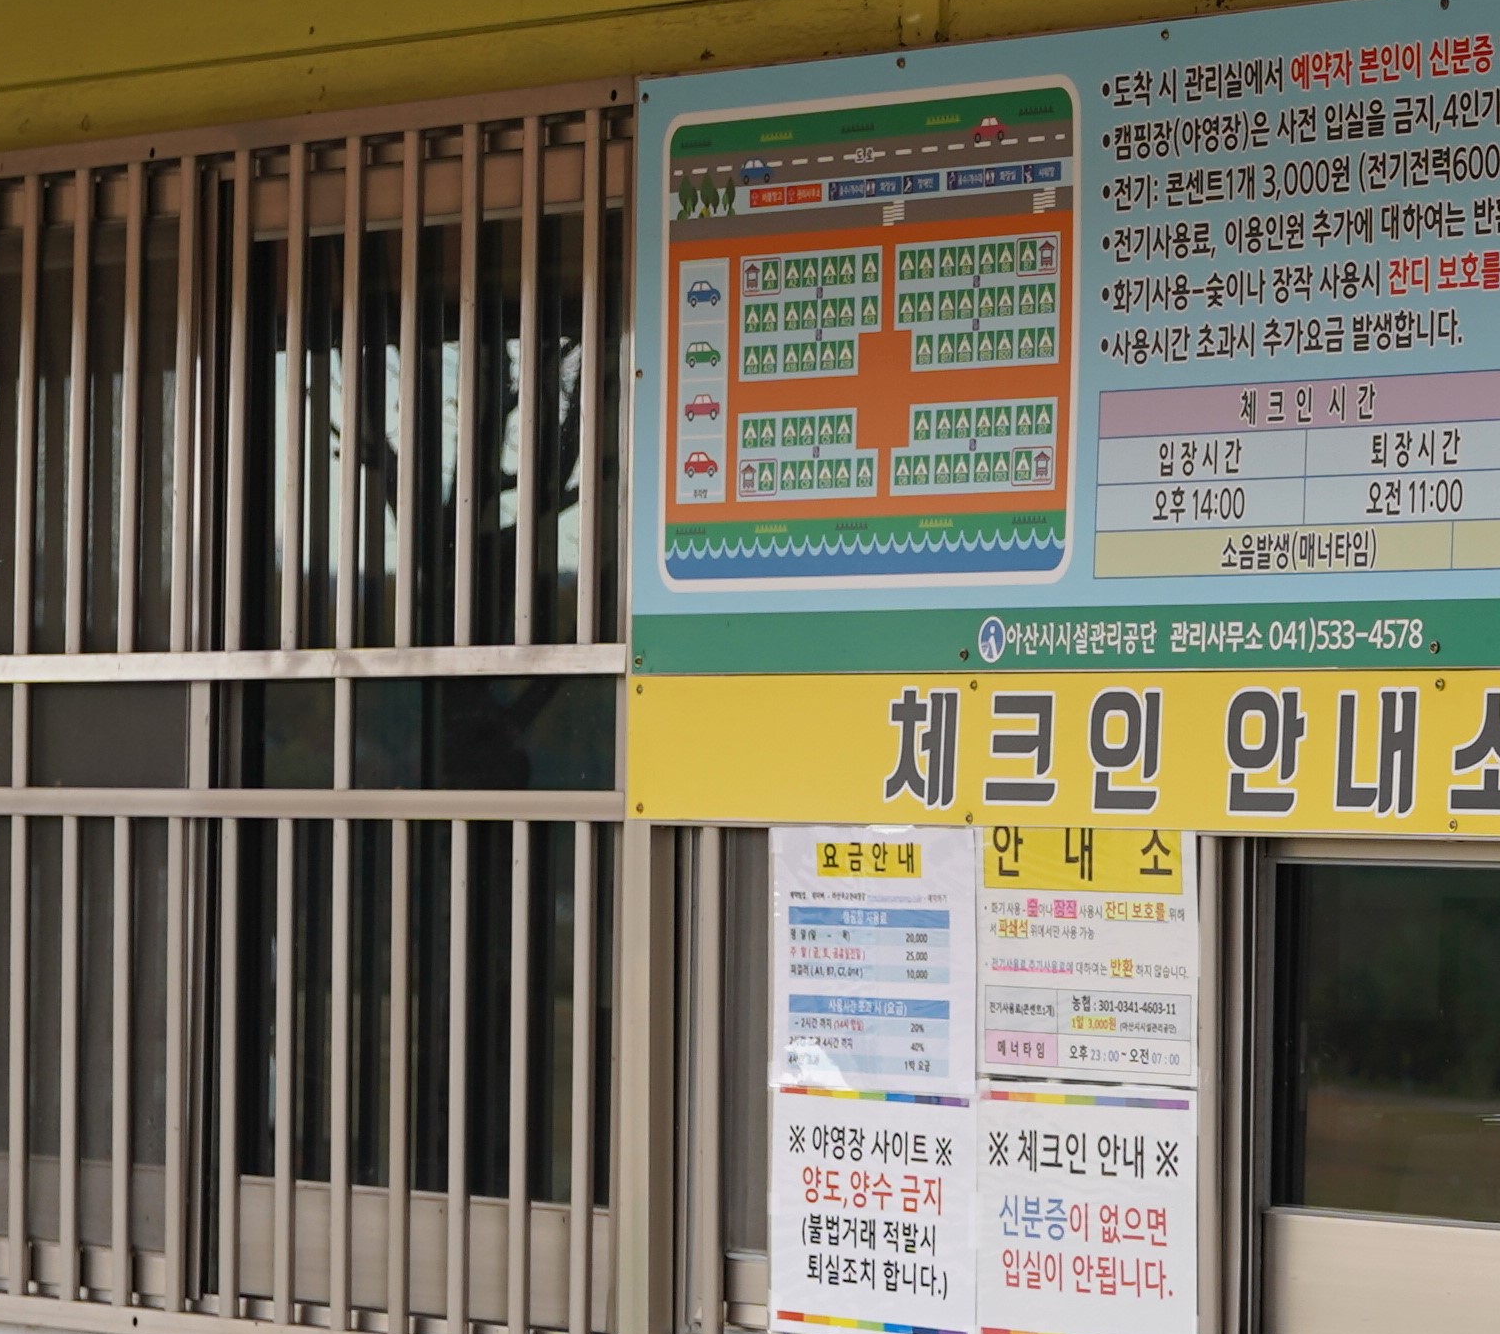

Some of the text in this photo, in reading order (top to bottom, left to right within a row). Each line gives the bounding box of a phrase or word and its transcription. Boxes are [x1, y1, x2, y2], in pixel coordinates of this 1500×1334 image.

[1113, 70, 1152, 107] 도착
[1159, 69, 1178, 103] 시
[1184, 56, 1285, 102] 관리실에서
[1291, 49, 1353, 90] 예약자
[1359, 42, 1422, 83] 본인이
[1430, 34, 1493, 77] 신분증
[1114, 109, 1269, 160] 캠핑장(야영장)은
[1277, 104, 1317, 146] 사전
[1325, 98, 1386, 141] 입실을
[1114, 174, 1159, 211] 전기:
[1166, 163, 1255, 206] 콘센트1개
[1263, 155, 1350, 201] 3,000원
[1114, 222, 1217, 263] 전기사용료,
[1225, 211, 1304, 254] 이용인원
[1312, 207, 1373, 247] 추가에
[1381, 199, 1465, 240] 대하여는
[1113, 269, 1265, 313] 화기사용-숯이나
[1273, 266, 1313, 303] 장작
[1320, 261, 1381, 299] 사용시
[1389, 257, 1430, 296] 잔디
[1112, 309, 1463, 365] 사용시간 초과시 추가요금 발생합니다.
[1159, 428, 1461, 476] 입장시간 퇴장시간
[1152, 486, 1246, 523] 오후 14:00
[1366, 479, 1463, 515] 오전 11:00
[1221, 529, 1378, 570] 소음발생(매너타임)
[1007, 618, 1423, 654] 아산시시설관리공단 관리사무소 041)533-4578
[884, 685, 1164, 812] 체크인
[823, 843, 914, 873] 요금안내
[1105, 901, 1165, 921] 잔디 보호를
[906, 933, 928, 944] 20,000
[906, 951, 928, 962] 25,000
[907, 969, 928, 979] 10,000
[1110, 959, 1133, 977] 반환
[1070, 1046, 1149, 1064] 오후 오전
[812, 1125, 928, 1165] 야영장 사이트
[1018, 1130, 1144, 1179] 체크인 안내
[803, 1166, 941, 1216] 양도,양수 금지
[803, 1214, 935, 1256] (불법거래 적발시
[1000, 1195, 1167, 1246] 신분증이 없으면
[807, 1253, 947, 1300] 퇴실조치 합니다.)
[1003, 1249, 1173, 1299] 입실이 안됩니다.
